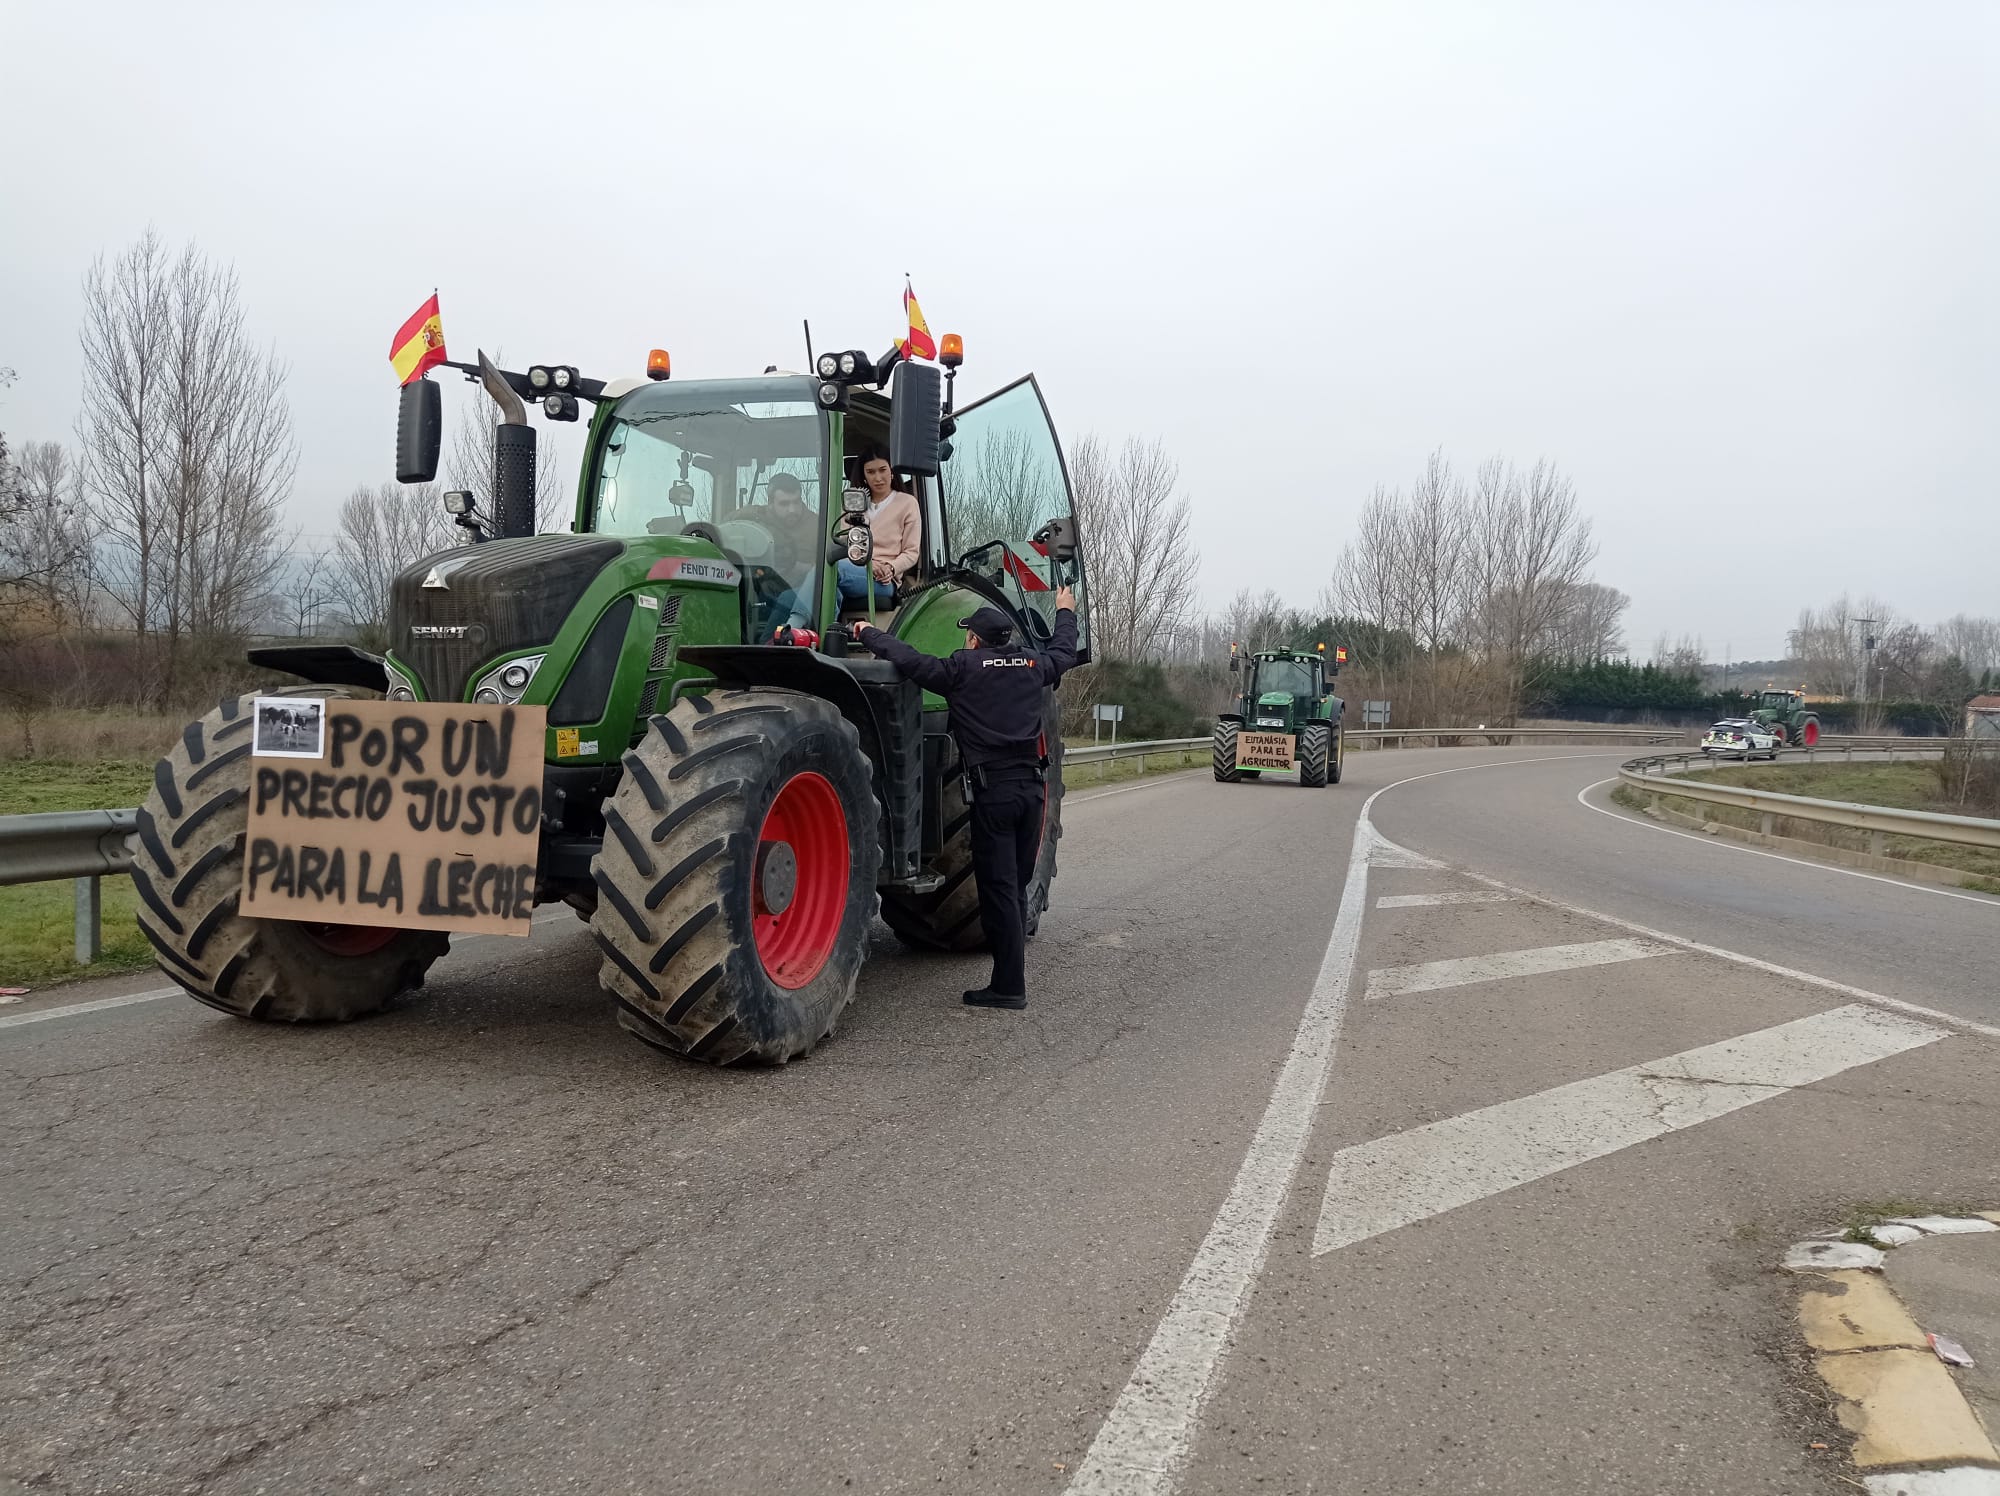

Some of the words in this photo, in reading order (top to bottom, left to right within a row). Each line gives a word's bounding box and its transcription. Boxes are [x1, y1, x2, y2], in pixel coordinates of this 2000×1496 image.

[681, 562, 709, 577] FENDT
[711, 567, 725, 579] 720
[411, 626, 469, 639] FENDT
[442, 708, 516, 779] UN
[1245, 735, 1287, 745] EUTANASIA
[1250, 745, 1274, 755] PARA
[1276, 747, 1289, 756] EL
[1241, 756, 1290, 769] AGRICULTOR
[256, 766, 393, 821] PRECIO
[402, 778, 541, 836] JUSTO
[248, 837, 346, 904] PARA
[357, 850, 404, 914] LA
[418, 857, 537, 920] LECHE
